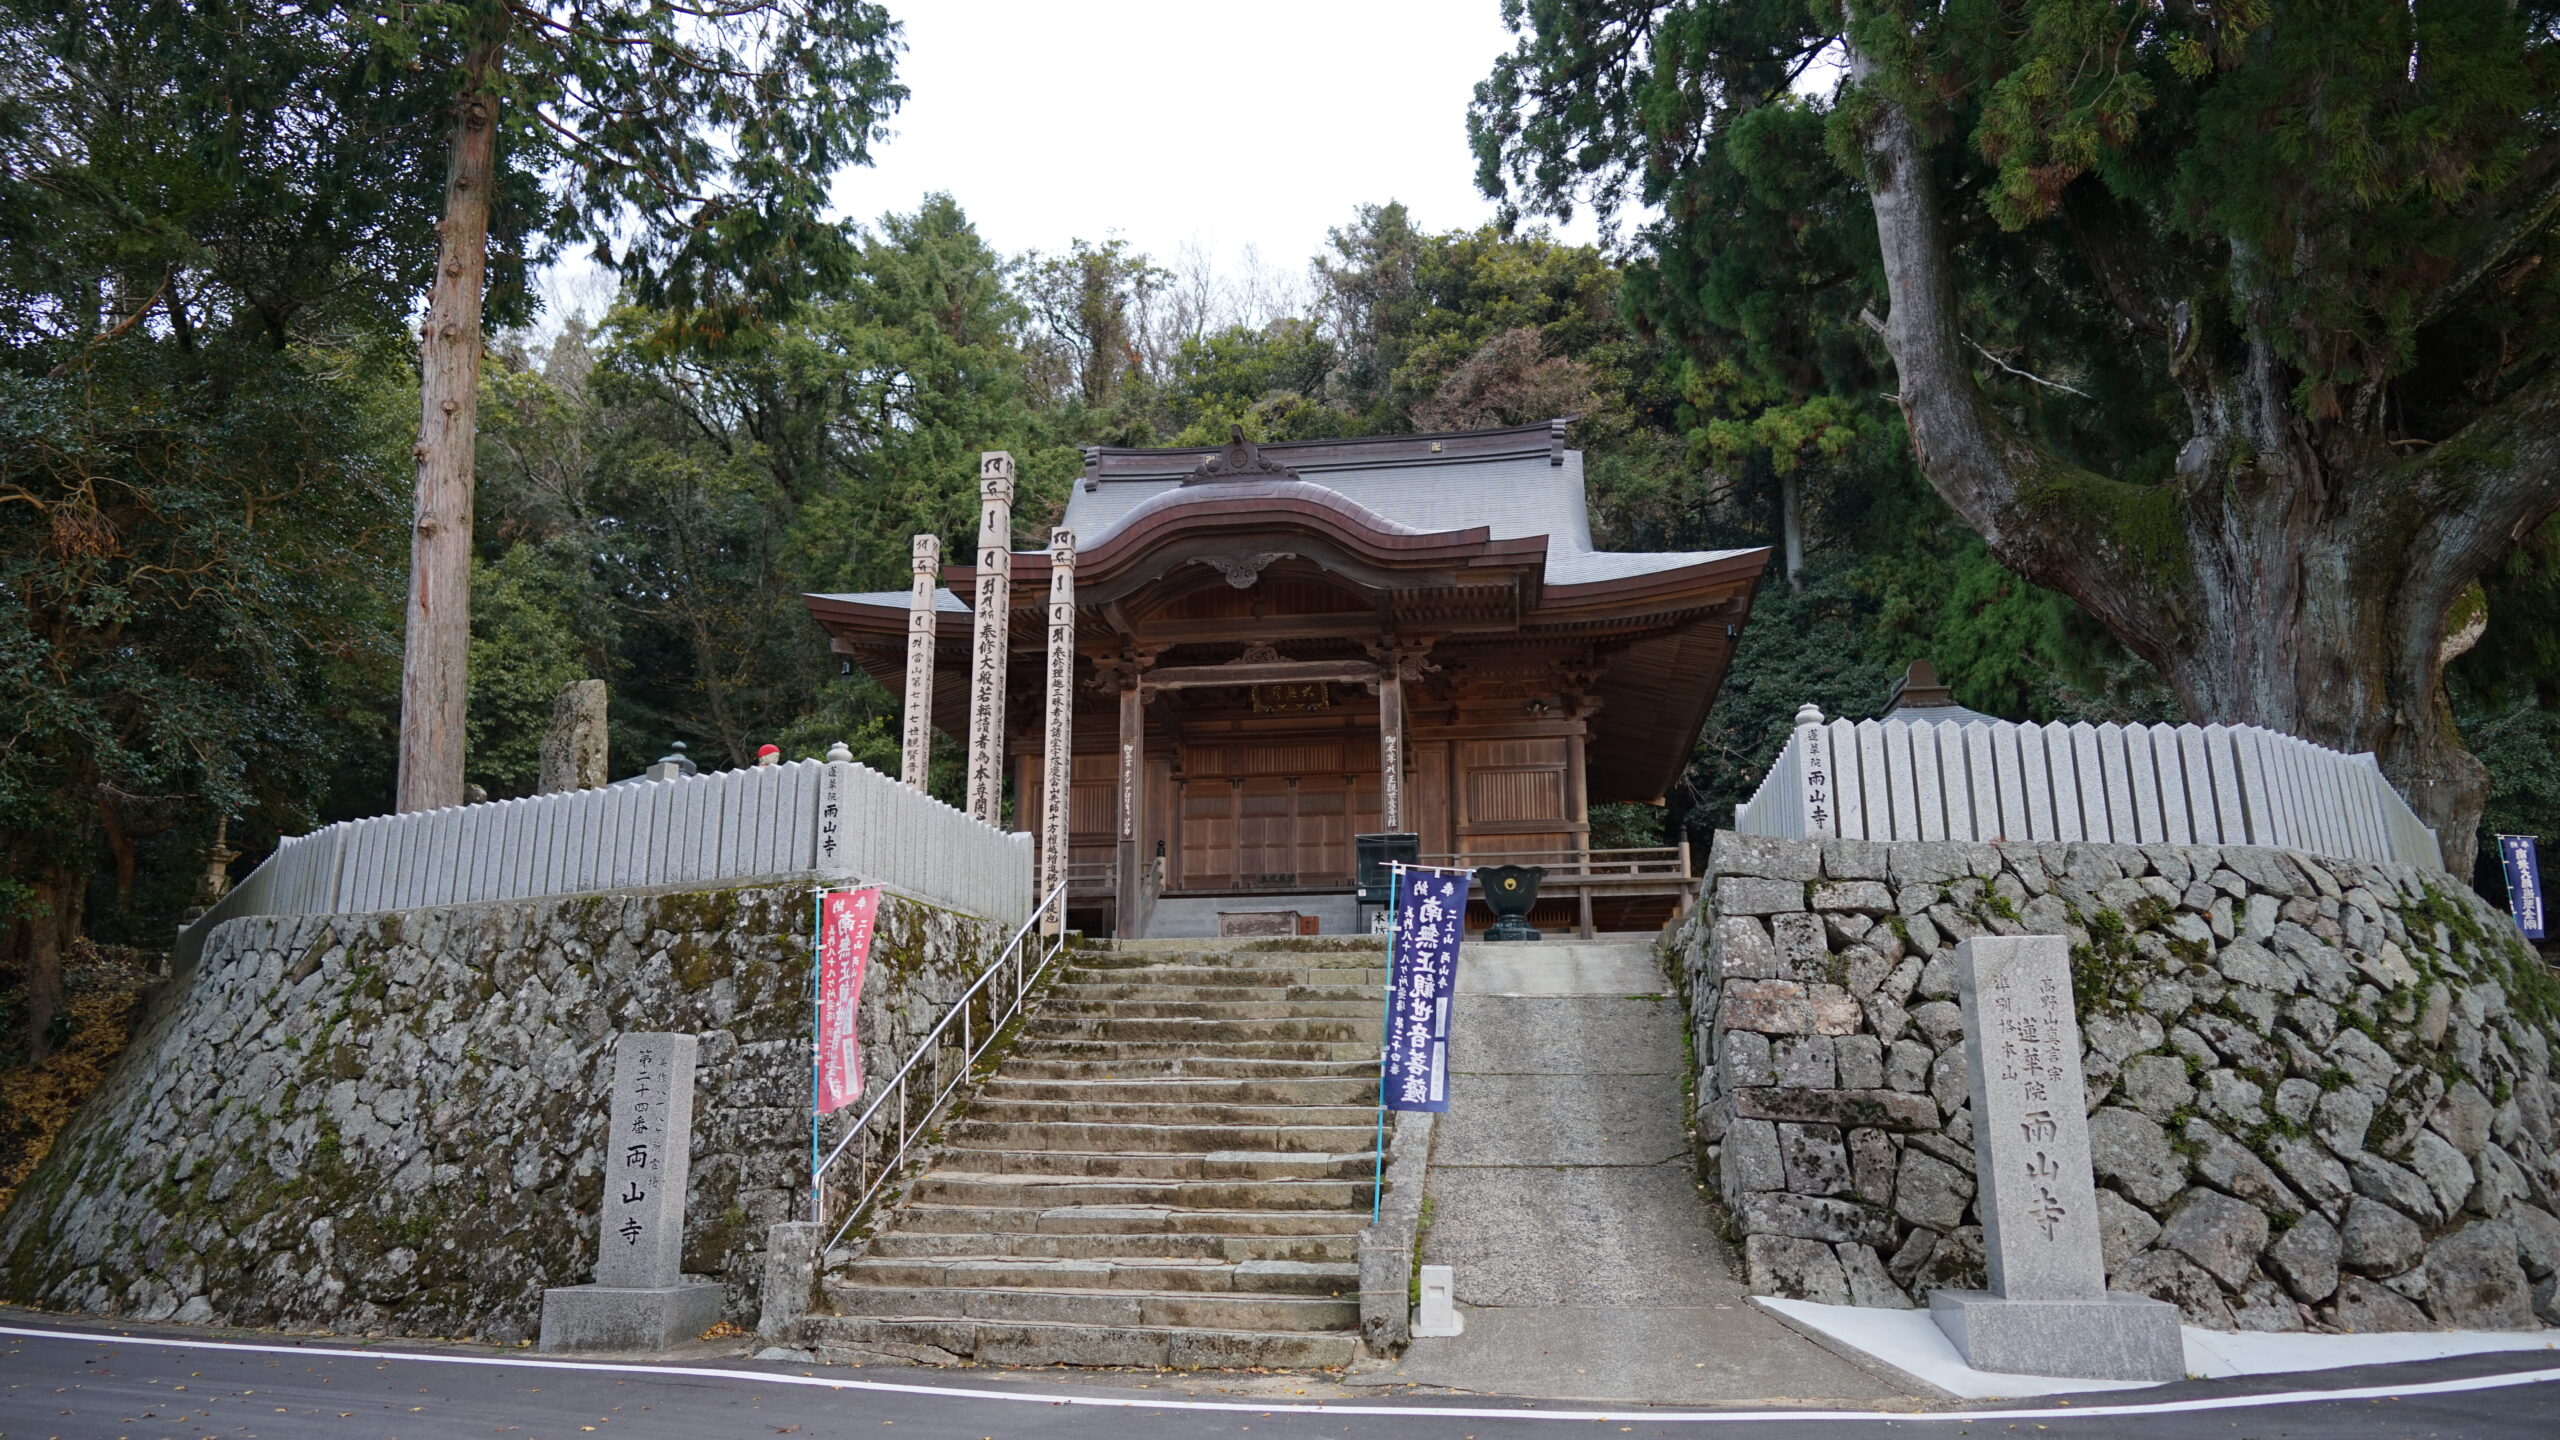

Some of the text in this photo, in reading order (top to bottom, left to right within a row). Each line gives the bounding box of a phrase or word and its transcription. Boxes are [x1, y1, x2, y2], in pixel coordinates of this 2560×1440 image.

[2039, 976, 2064, 1082] 高野山真言宗
